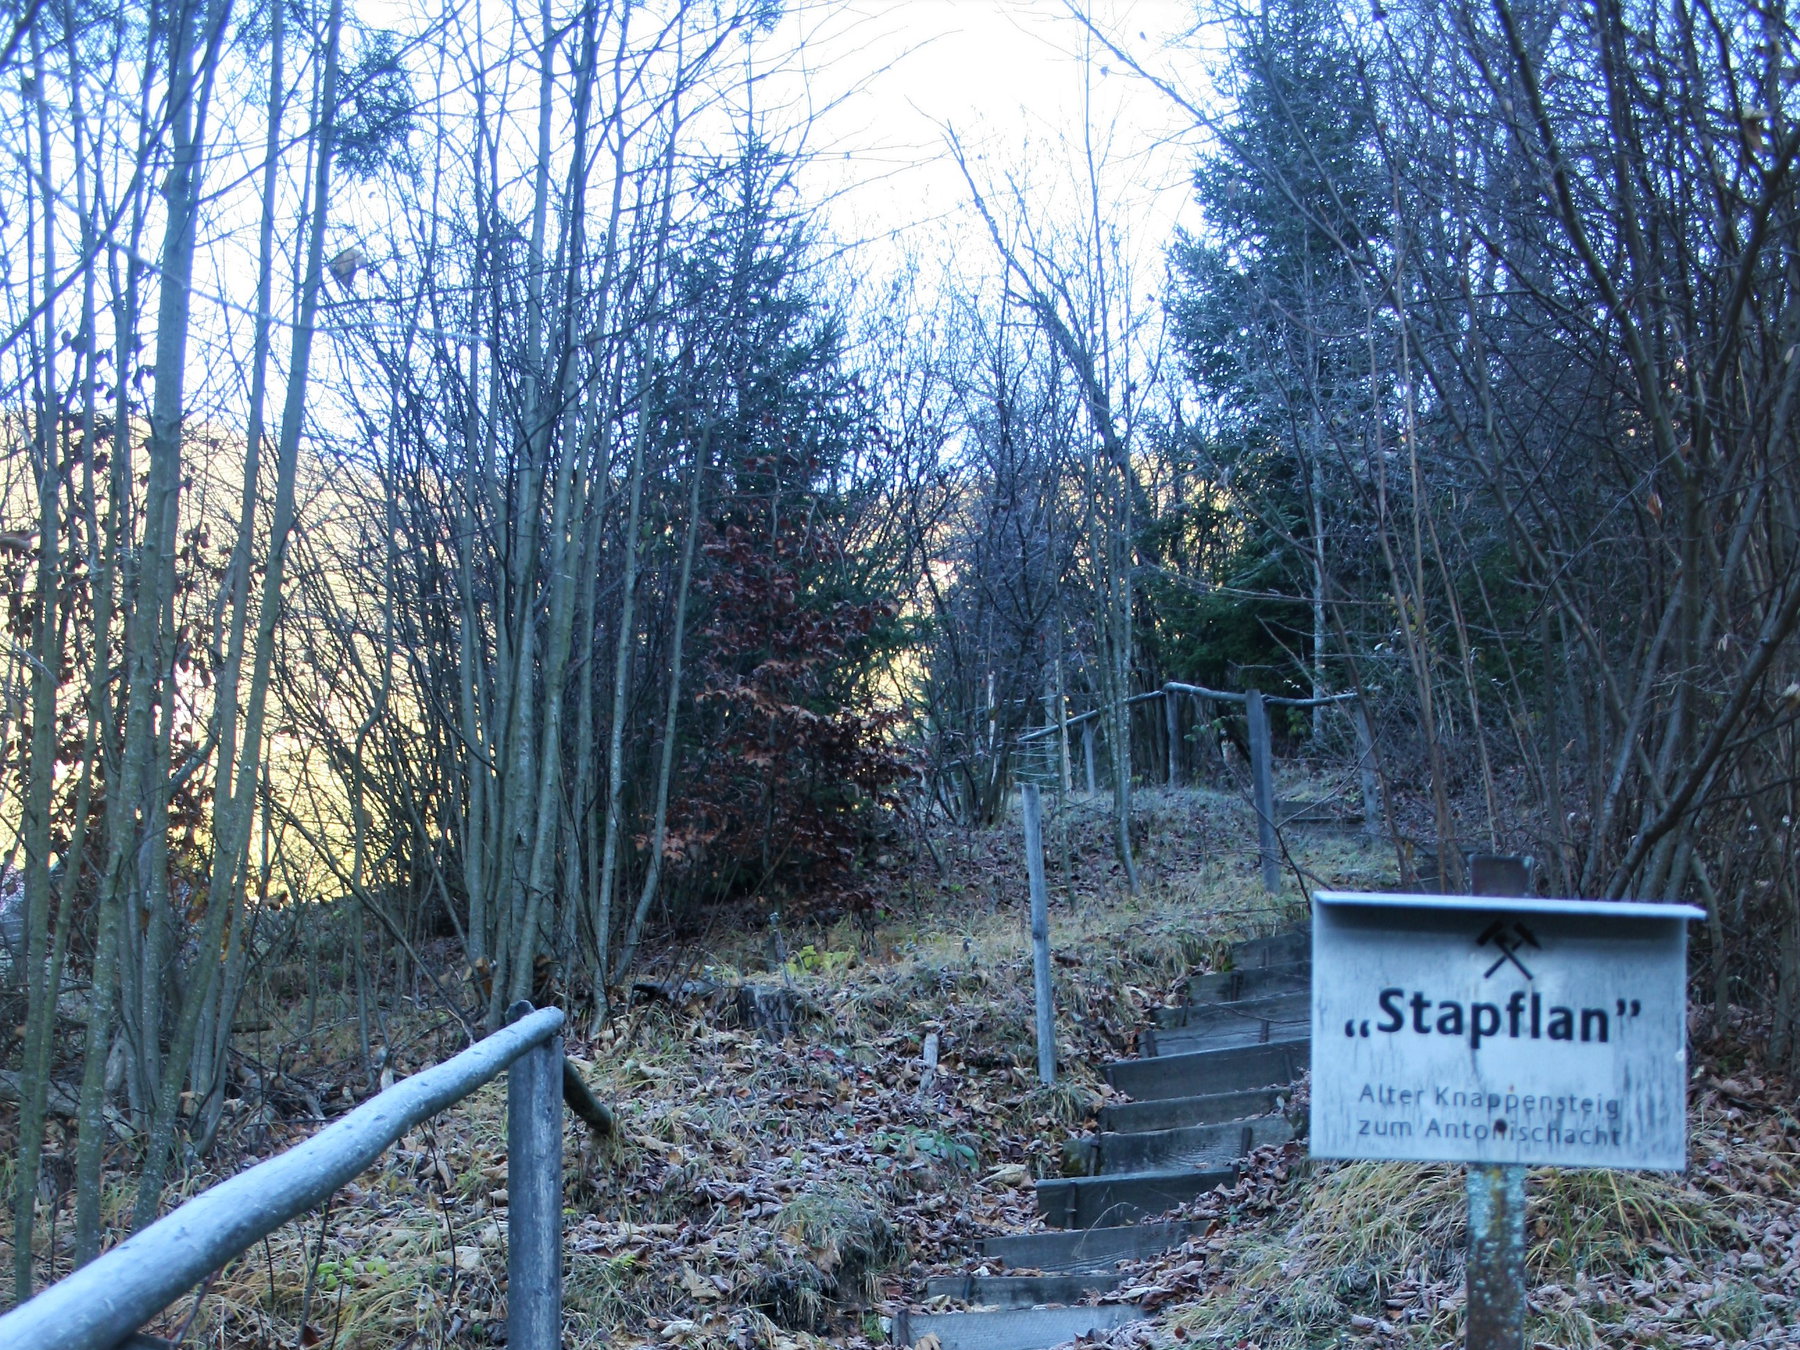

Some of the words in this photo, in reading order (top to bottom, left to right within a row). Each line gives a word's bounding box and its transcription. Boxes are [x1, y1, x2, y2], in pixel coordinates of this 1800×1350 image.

[1358, 1083, 1424, 1105] Alter
[1435, 1086, 1620, 1120] Knappensteig
[1358, 1119, 1412, 1137] zum
